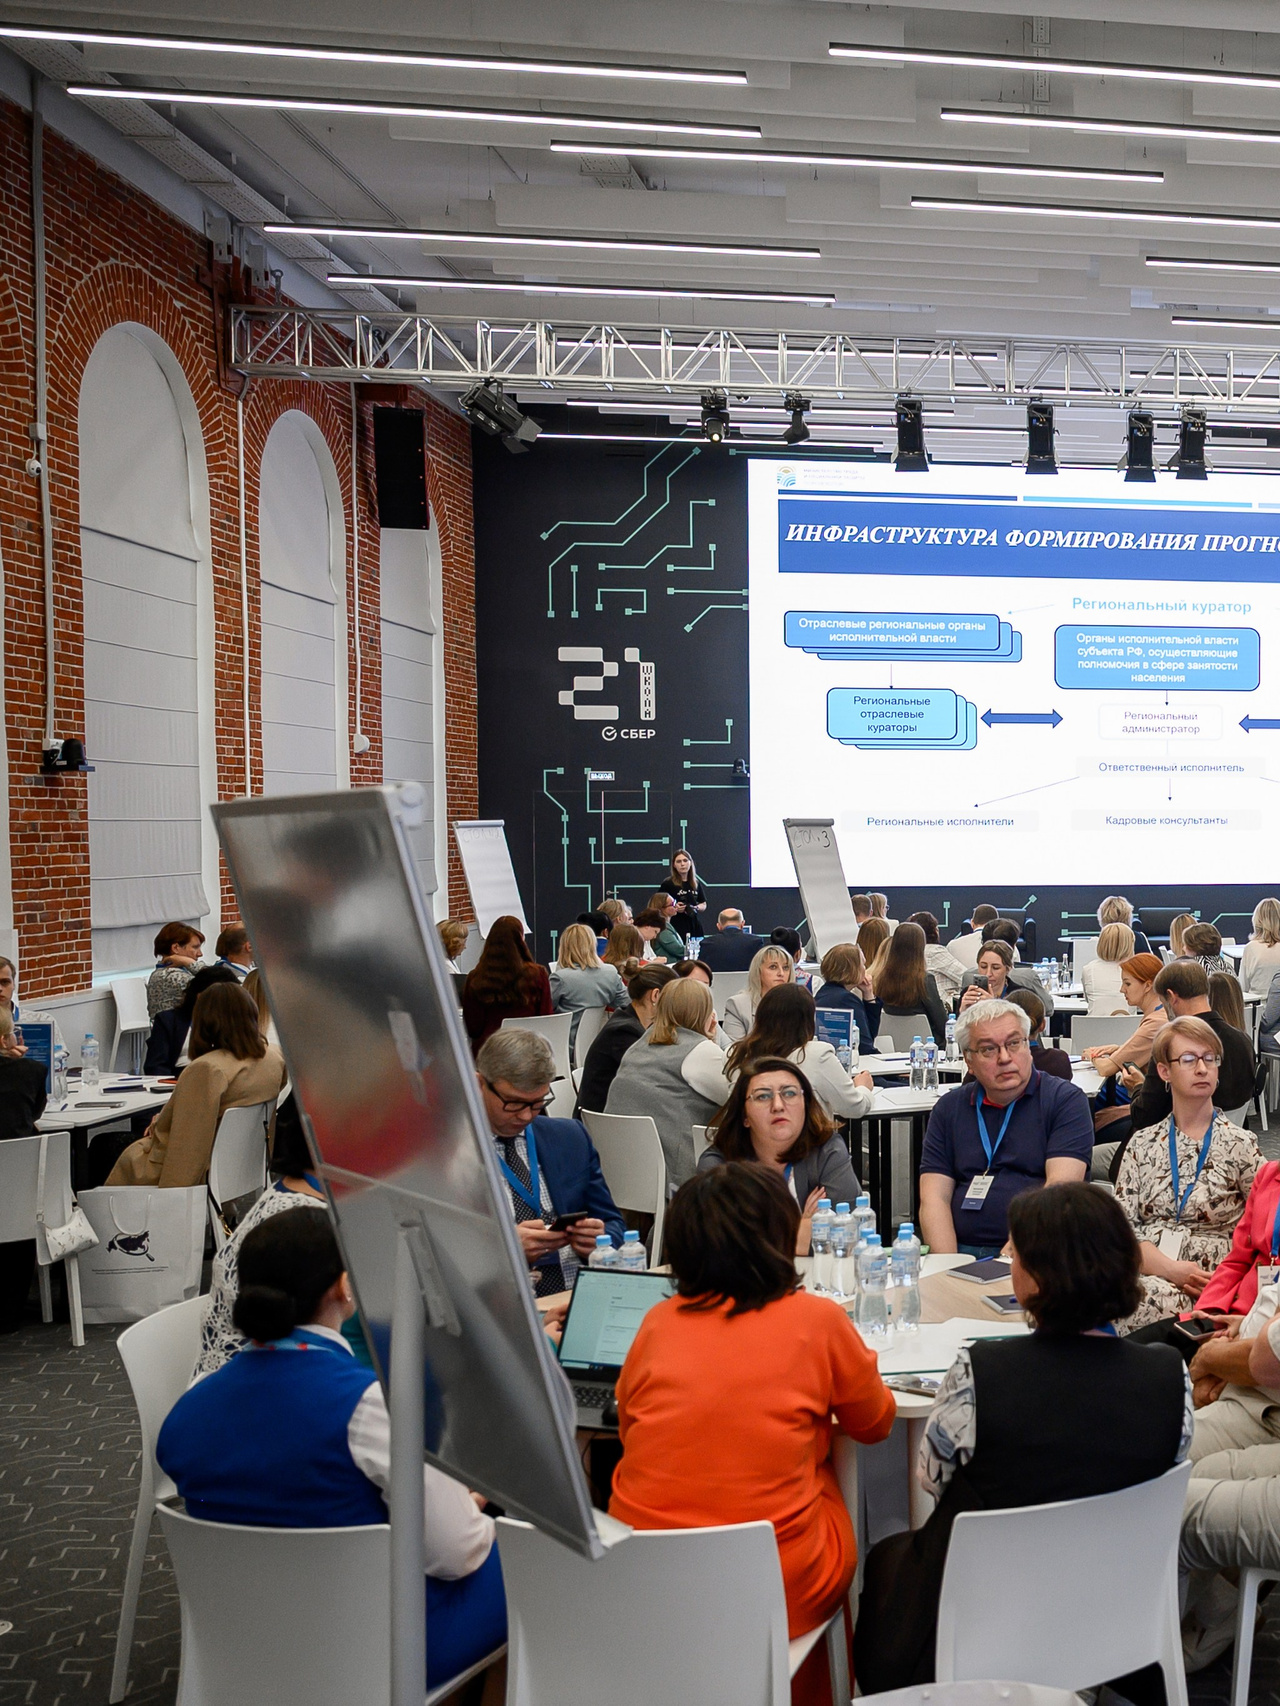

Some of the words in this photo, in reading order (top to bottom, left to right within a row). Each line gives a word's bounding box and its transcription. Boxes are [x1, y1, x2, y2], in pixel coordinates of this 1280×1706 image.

[785, 524, 998, 546] ИНФРАСТРУКТУРА
[1005, 528, 1198, 551] ФОРМИРОВАНИЯ
[1073, 597, 1187, 611] Региональный
[1192, 602, 1251, 615] куратор
[799, 618, 866, 629] Отраслевые
[869, 620, 945, 631] региональные
[948, 622, 985, 632] органы
[830, 632, 913, 643] исполнительной
[915, 634, 956, 643] власти
[1077, 633, 1115, 645] Органы
[1118, 633, 1202, 645] исполнительной
[1204, 635, 1238, 645] власти
[1078, 647, 1124, 658] субъекта
[1127, 647, 1145, 658] РФ,
[1148, 648, 1237, 659] осуществляющие
[1078, 660, 1140, 669] полномочия
[1143, 661, 1149, 669] в
[1151, 660, 1185, 672] сфере
[1187, 661, 1238, 670] занятости
[1131, 673, 1185, 682] населения
[854, 696, 930, 707] Региональные
[860, 710, 924, 720] отраслевые
[1125, 711, 1197, 722] Региональный
[620, 729, 656, 739] СБЕР
[868, 723, 917, 734] кураторы
[1122, 725, 1200, 735] администратор
[1099, 762, 1177, 772] Ответственный
[1181, 763, 1244, 773] исполнитель
[867, 816, 944, 828] Региональные
[947, 816, 1014, 826] исполнители
[1106, 816, 1157, 827] Кадровые
[1160, 817, 1227, 826] консультанты
